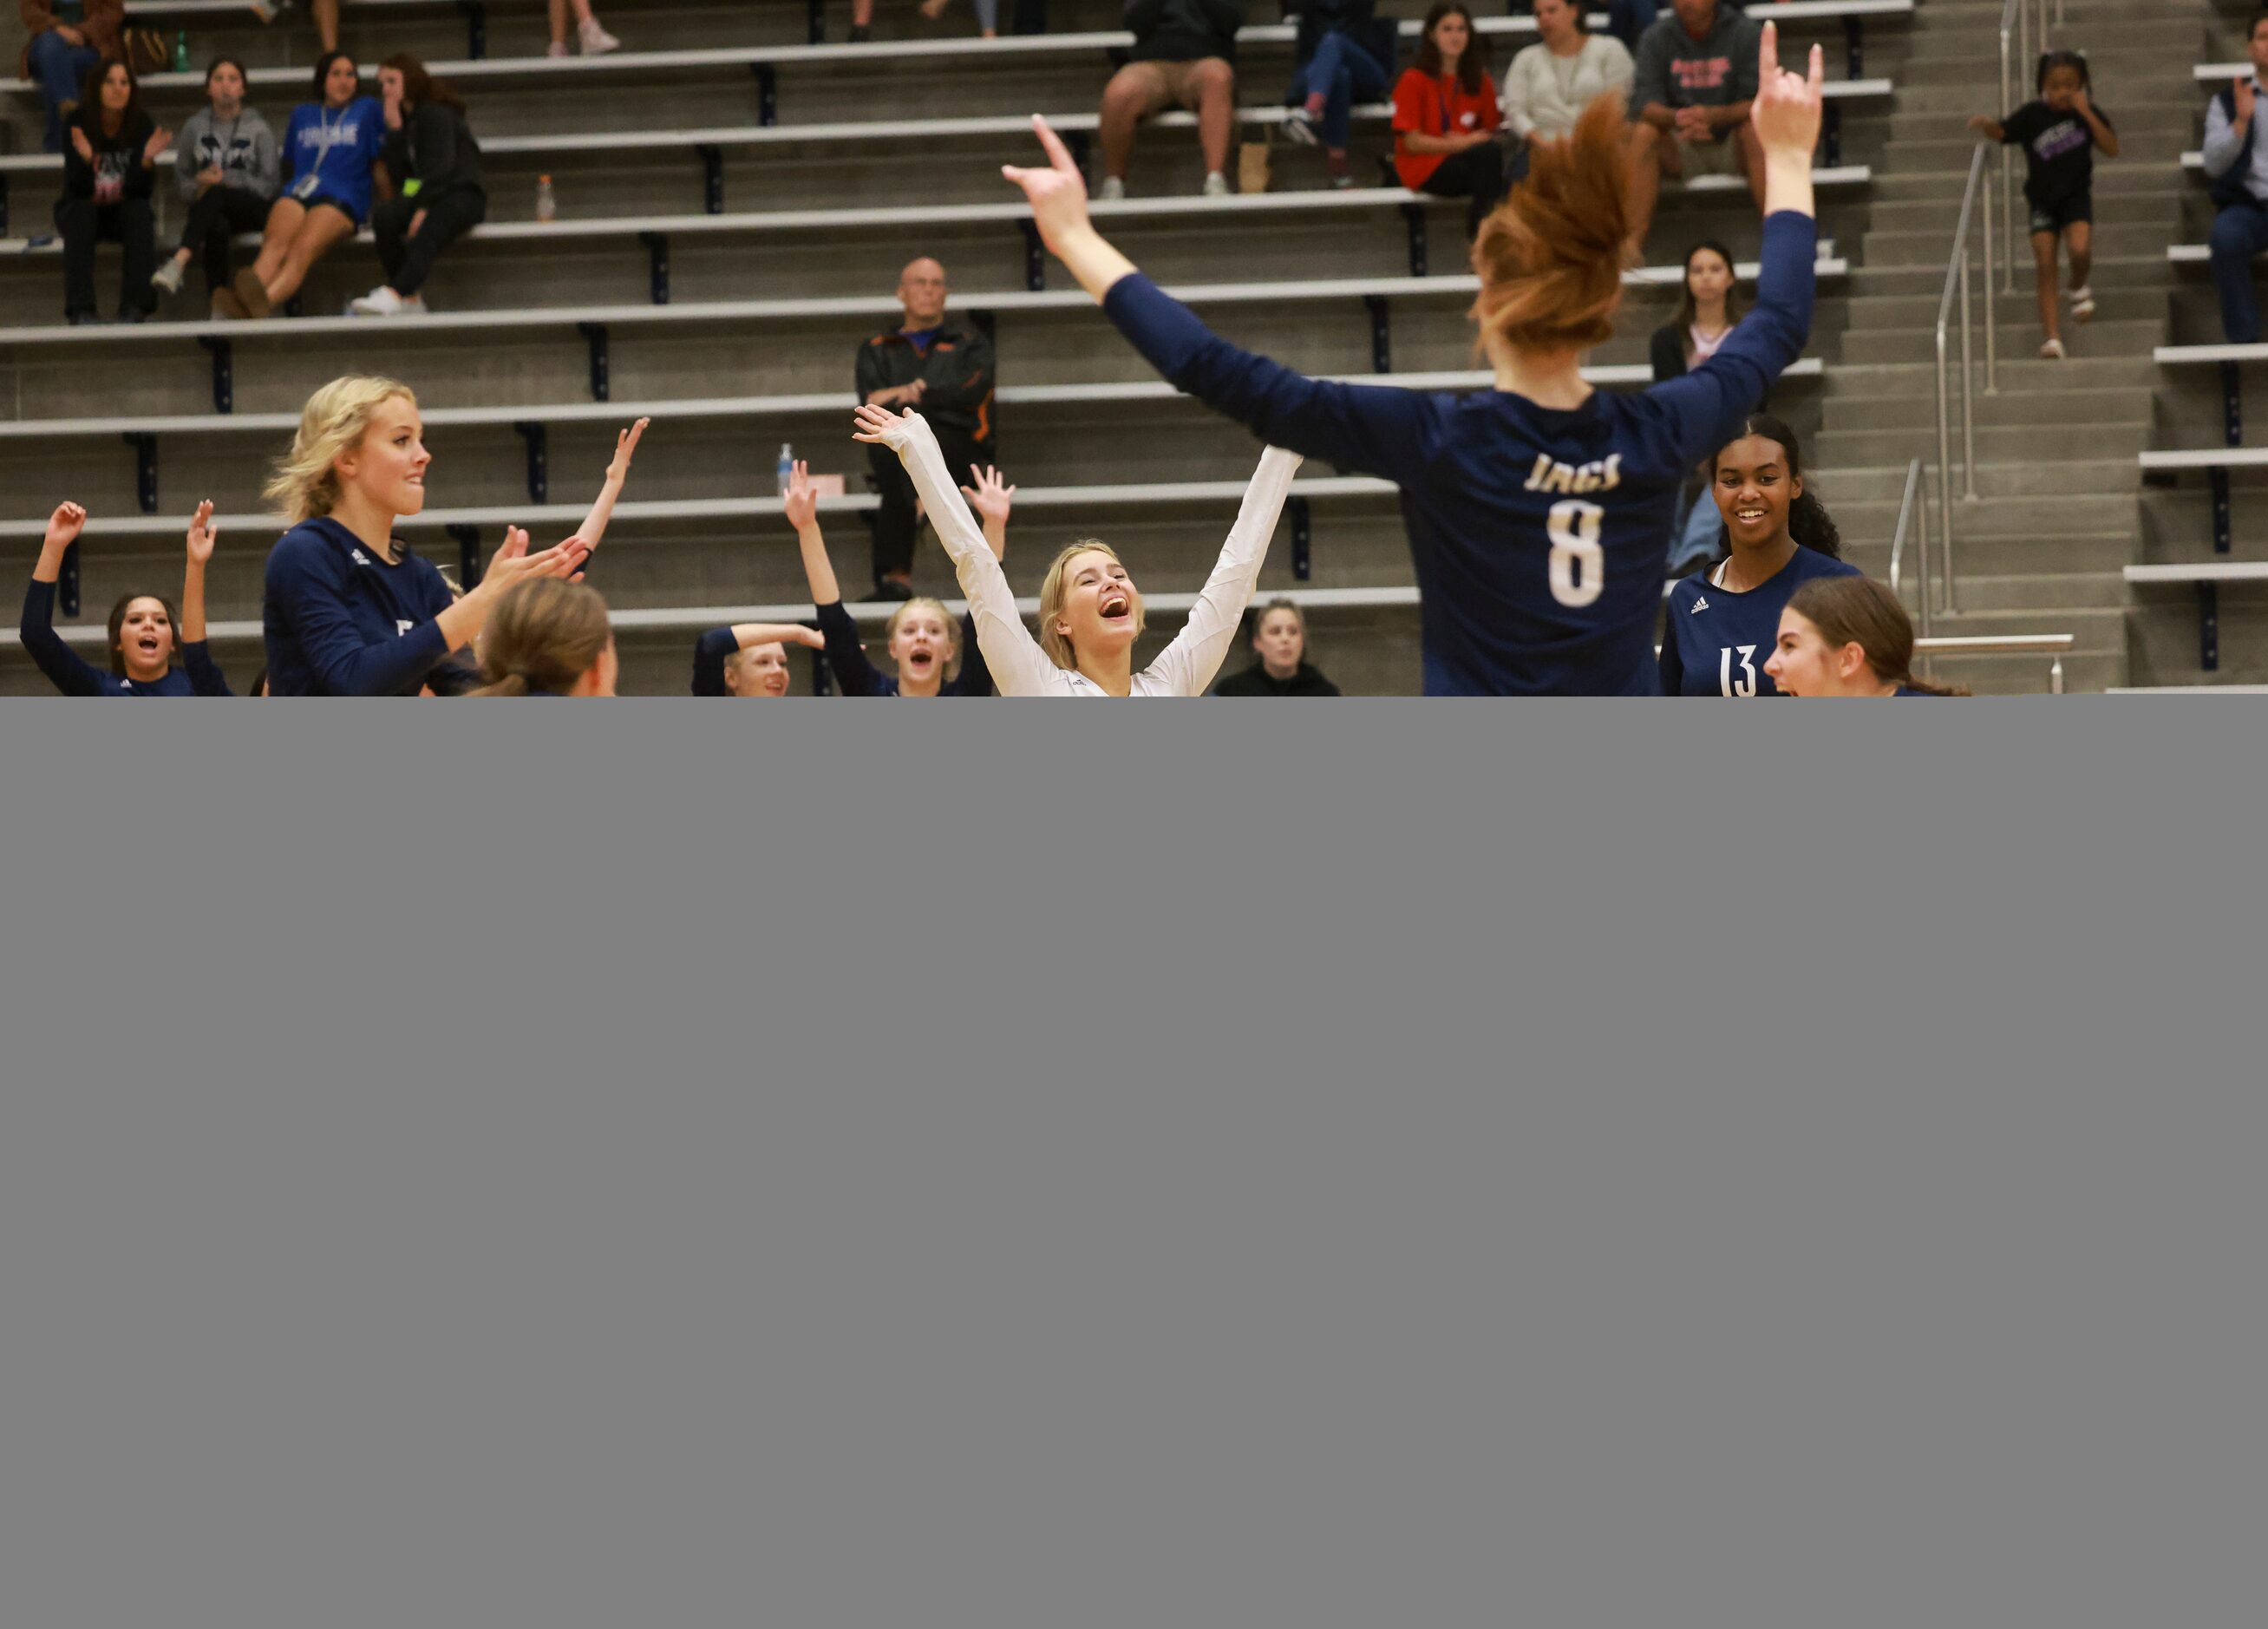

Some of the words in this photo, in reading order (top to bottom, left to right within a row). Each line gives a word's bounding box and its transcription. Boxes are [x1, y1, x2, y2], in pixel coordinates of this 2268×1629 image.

[1523, 452, 1622, 494] JAGS
[1546, 498, 1605, 608] 8
[1720, 644, 1757, 697] 13
